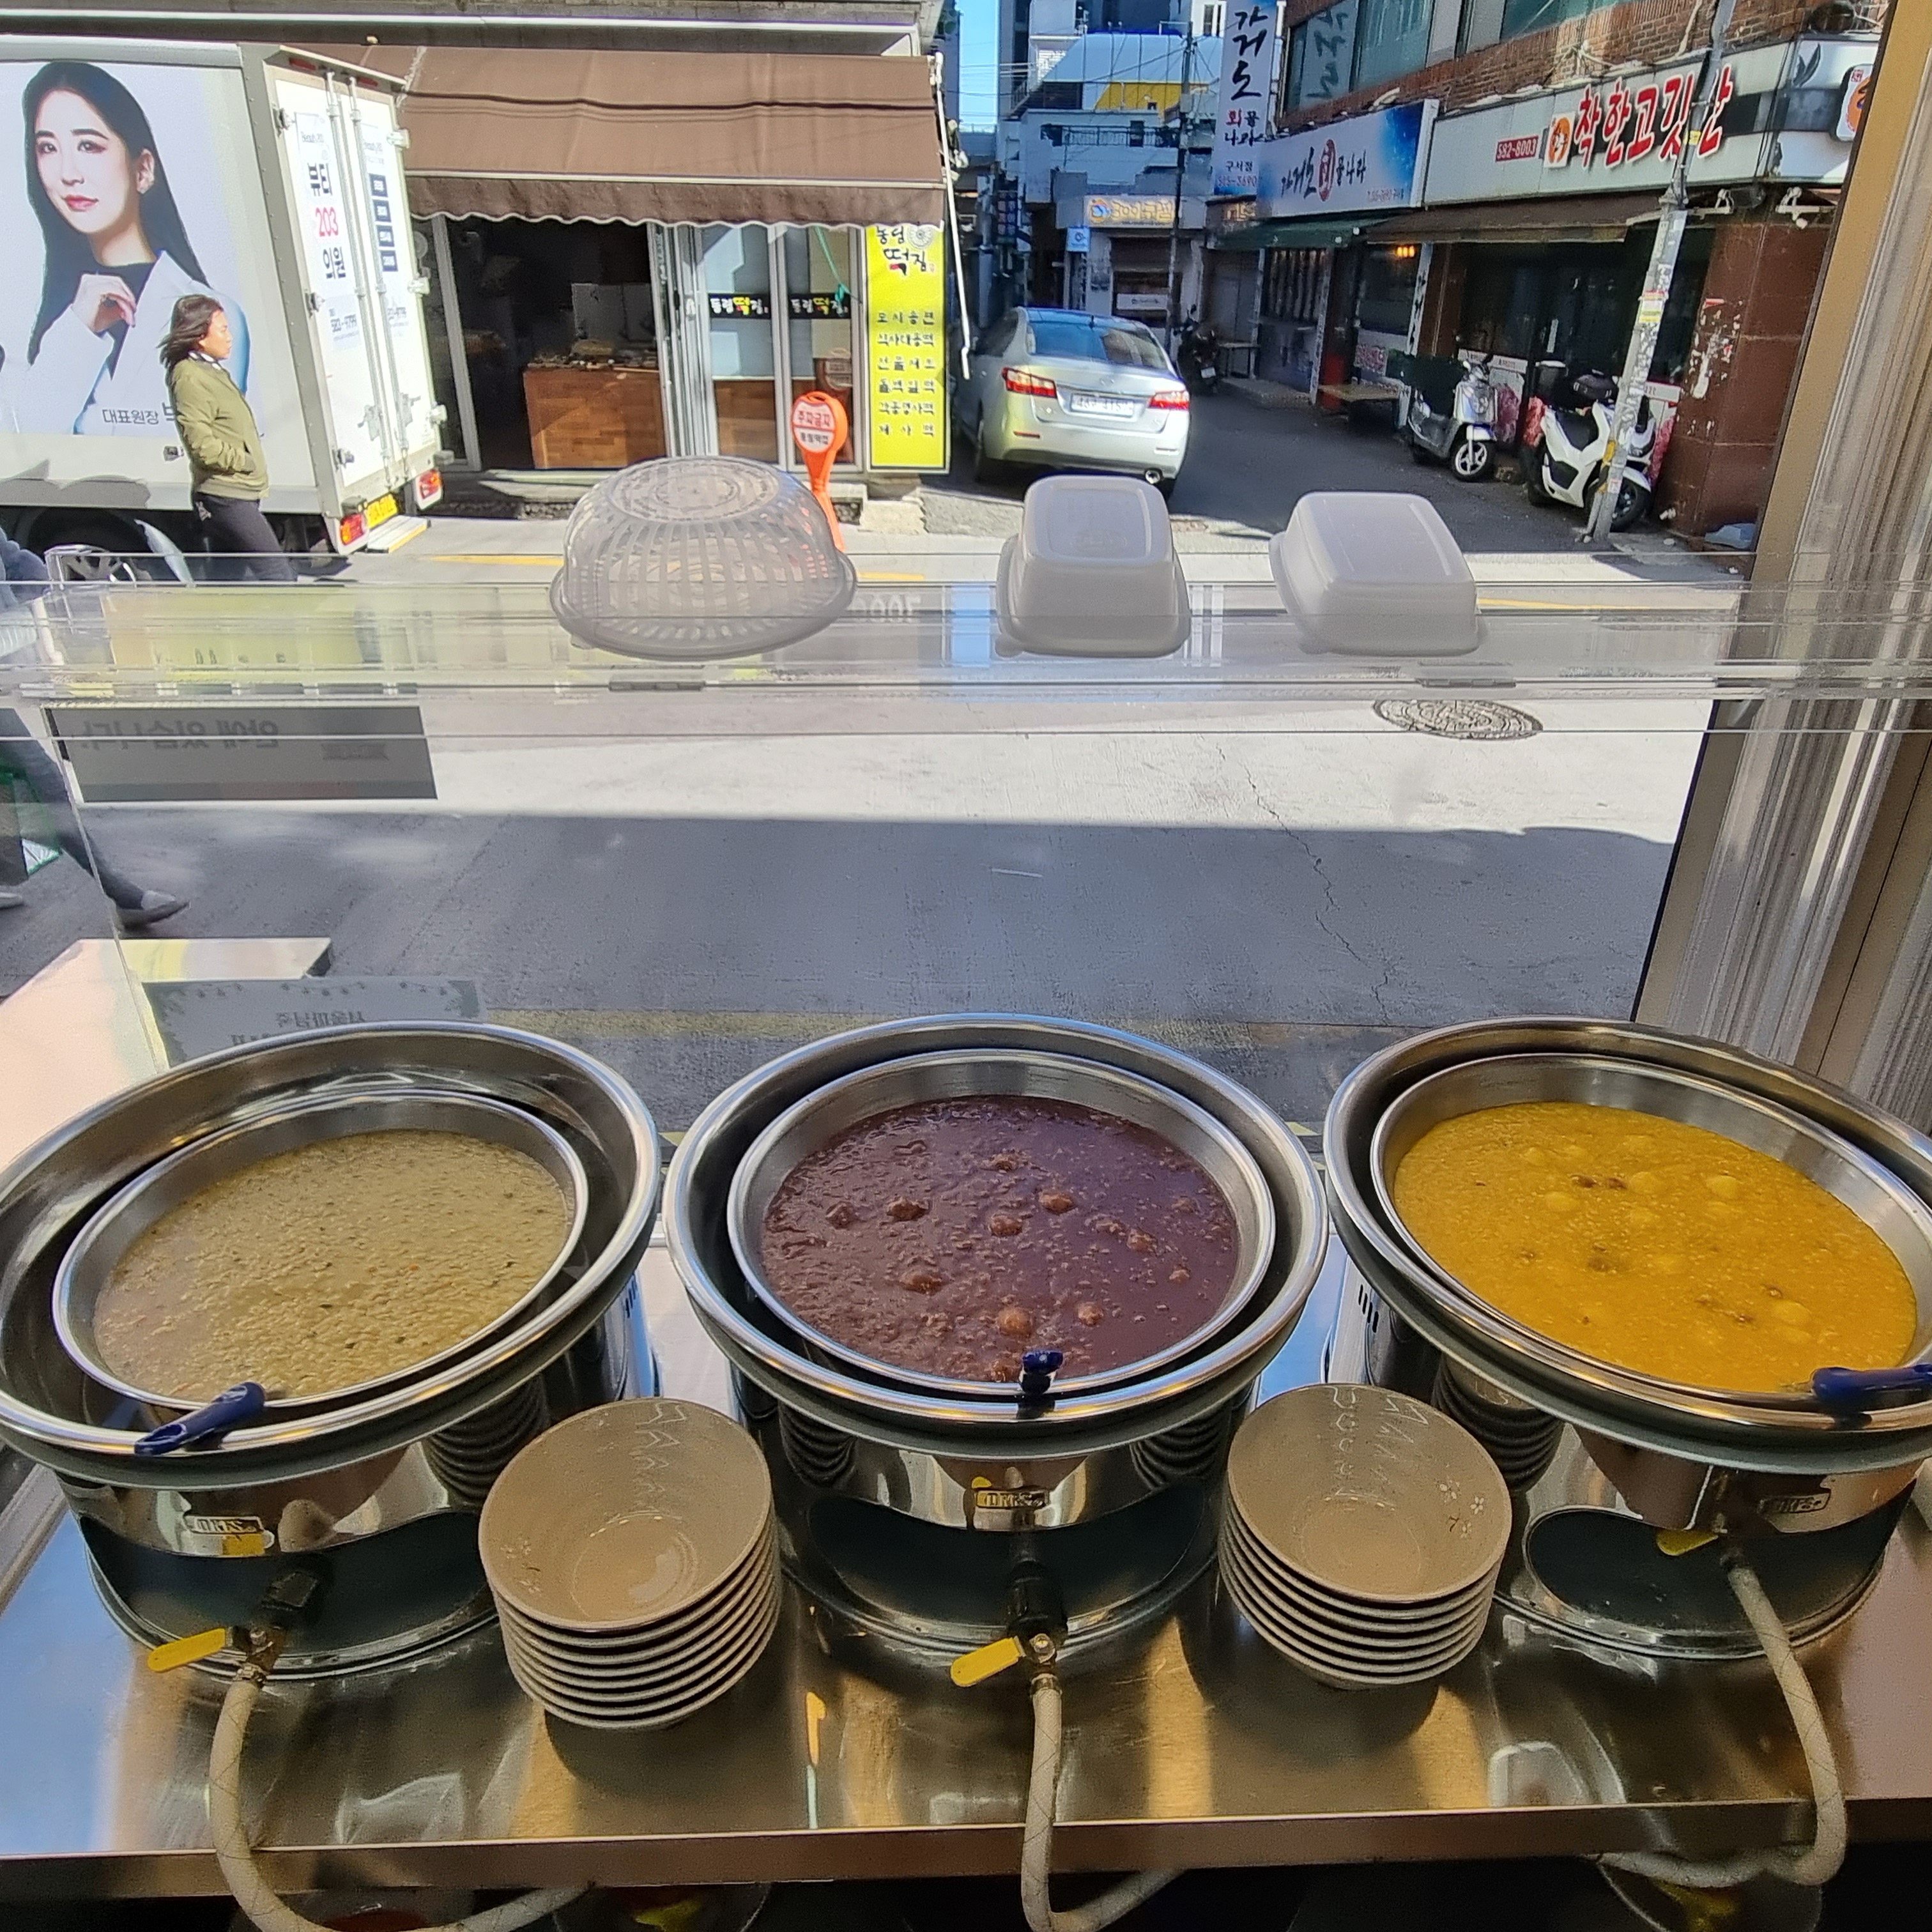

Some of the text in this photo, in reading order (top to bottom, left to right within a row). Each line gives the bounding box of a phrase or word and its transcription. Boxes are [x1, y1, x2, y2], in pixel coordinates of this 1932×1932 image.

[1231, 5, 1268, 101] 가거도
[307, 162, 333, 197] 뷰티
[315, 206, 339, 238] 203
[323, 245, 346, 280] 의원
[883, 248, 927, 276] 떡집
[102, 408, 160, 425] 대표원장
